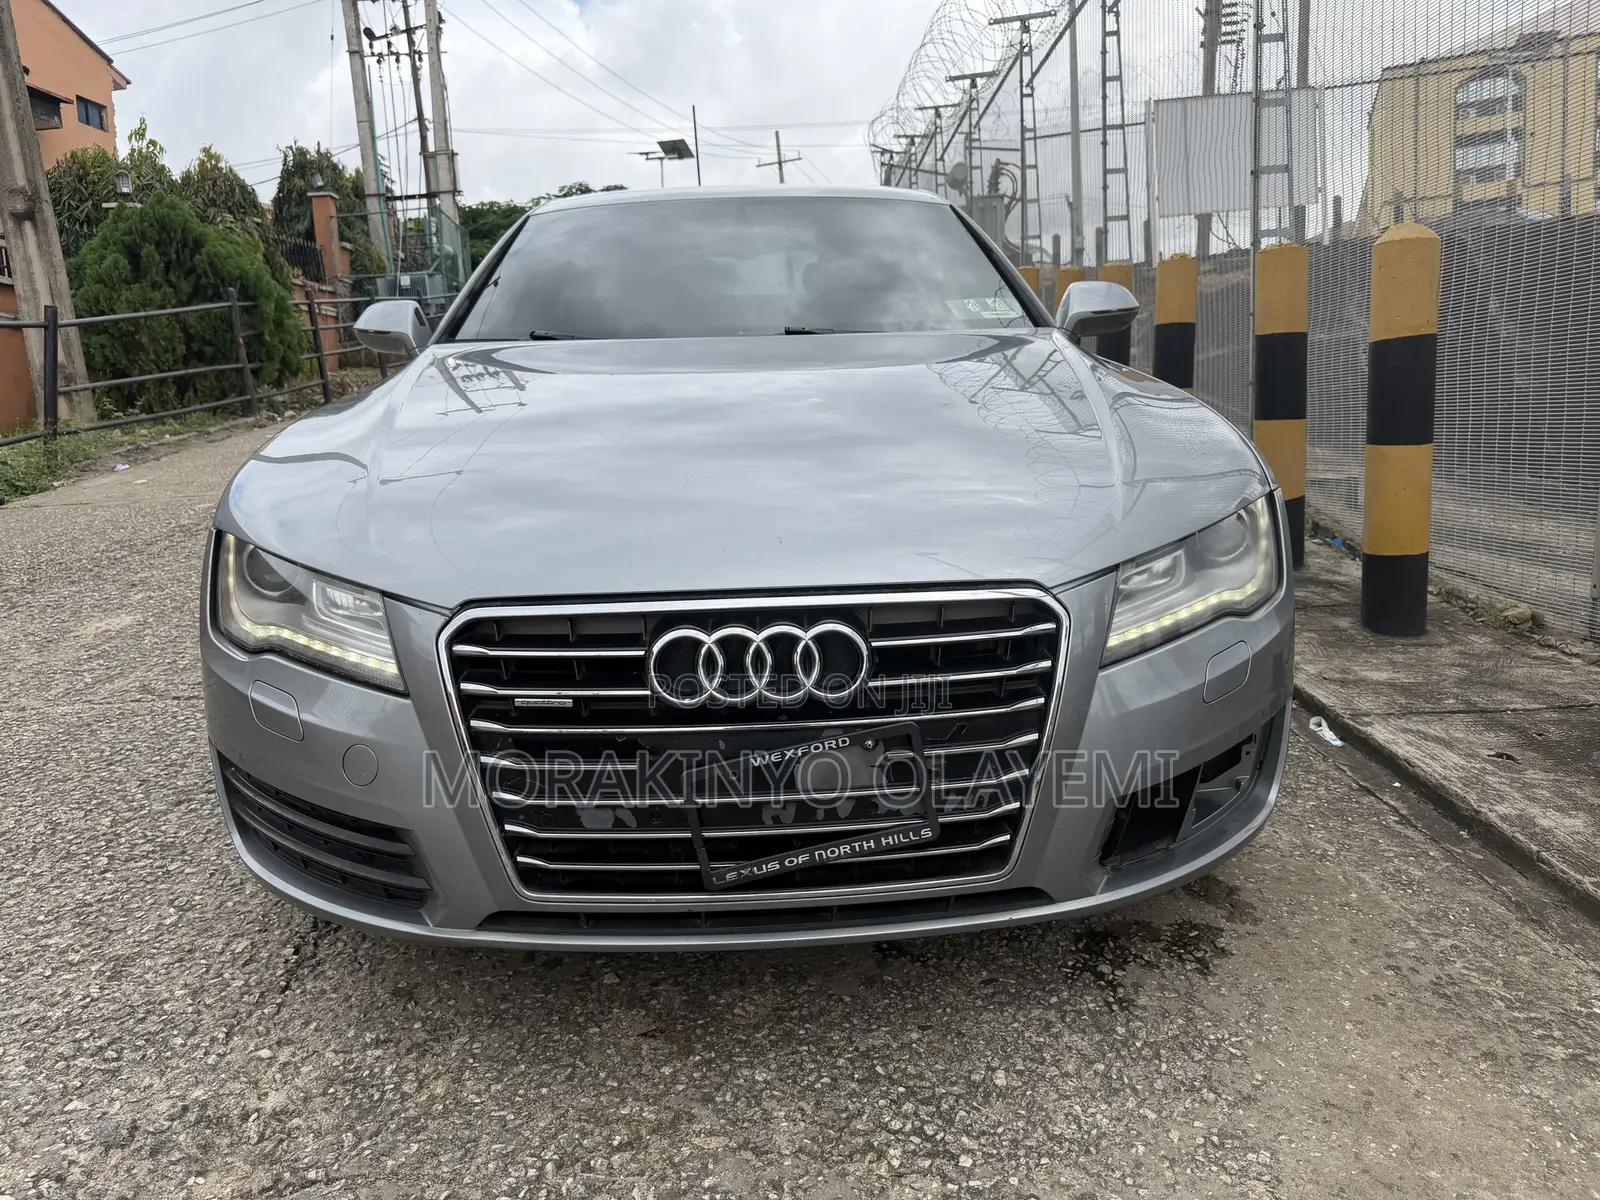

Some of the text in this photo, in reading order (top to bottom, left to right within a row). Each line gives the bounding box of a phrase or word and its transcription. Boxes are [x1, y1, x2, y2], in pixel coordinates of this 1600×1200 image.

[750, 737, 850, 767] WEXFORD
[712, 828, 933, 885] LEXUS OF NORTH HILLS
